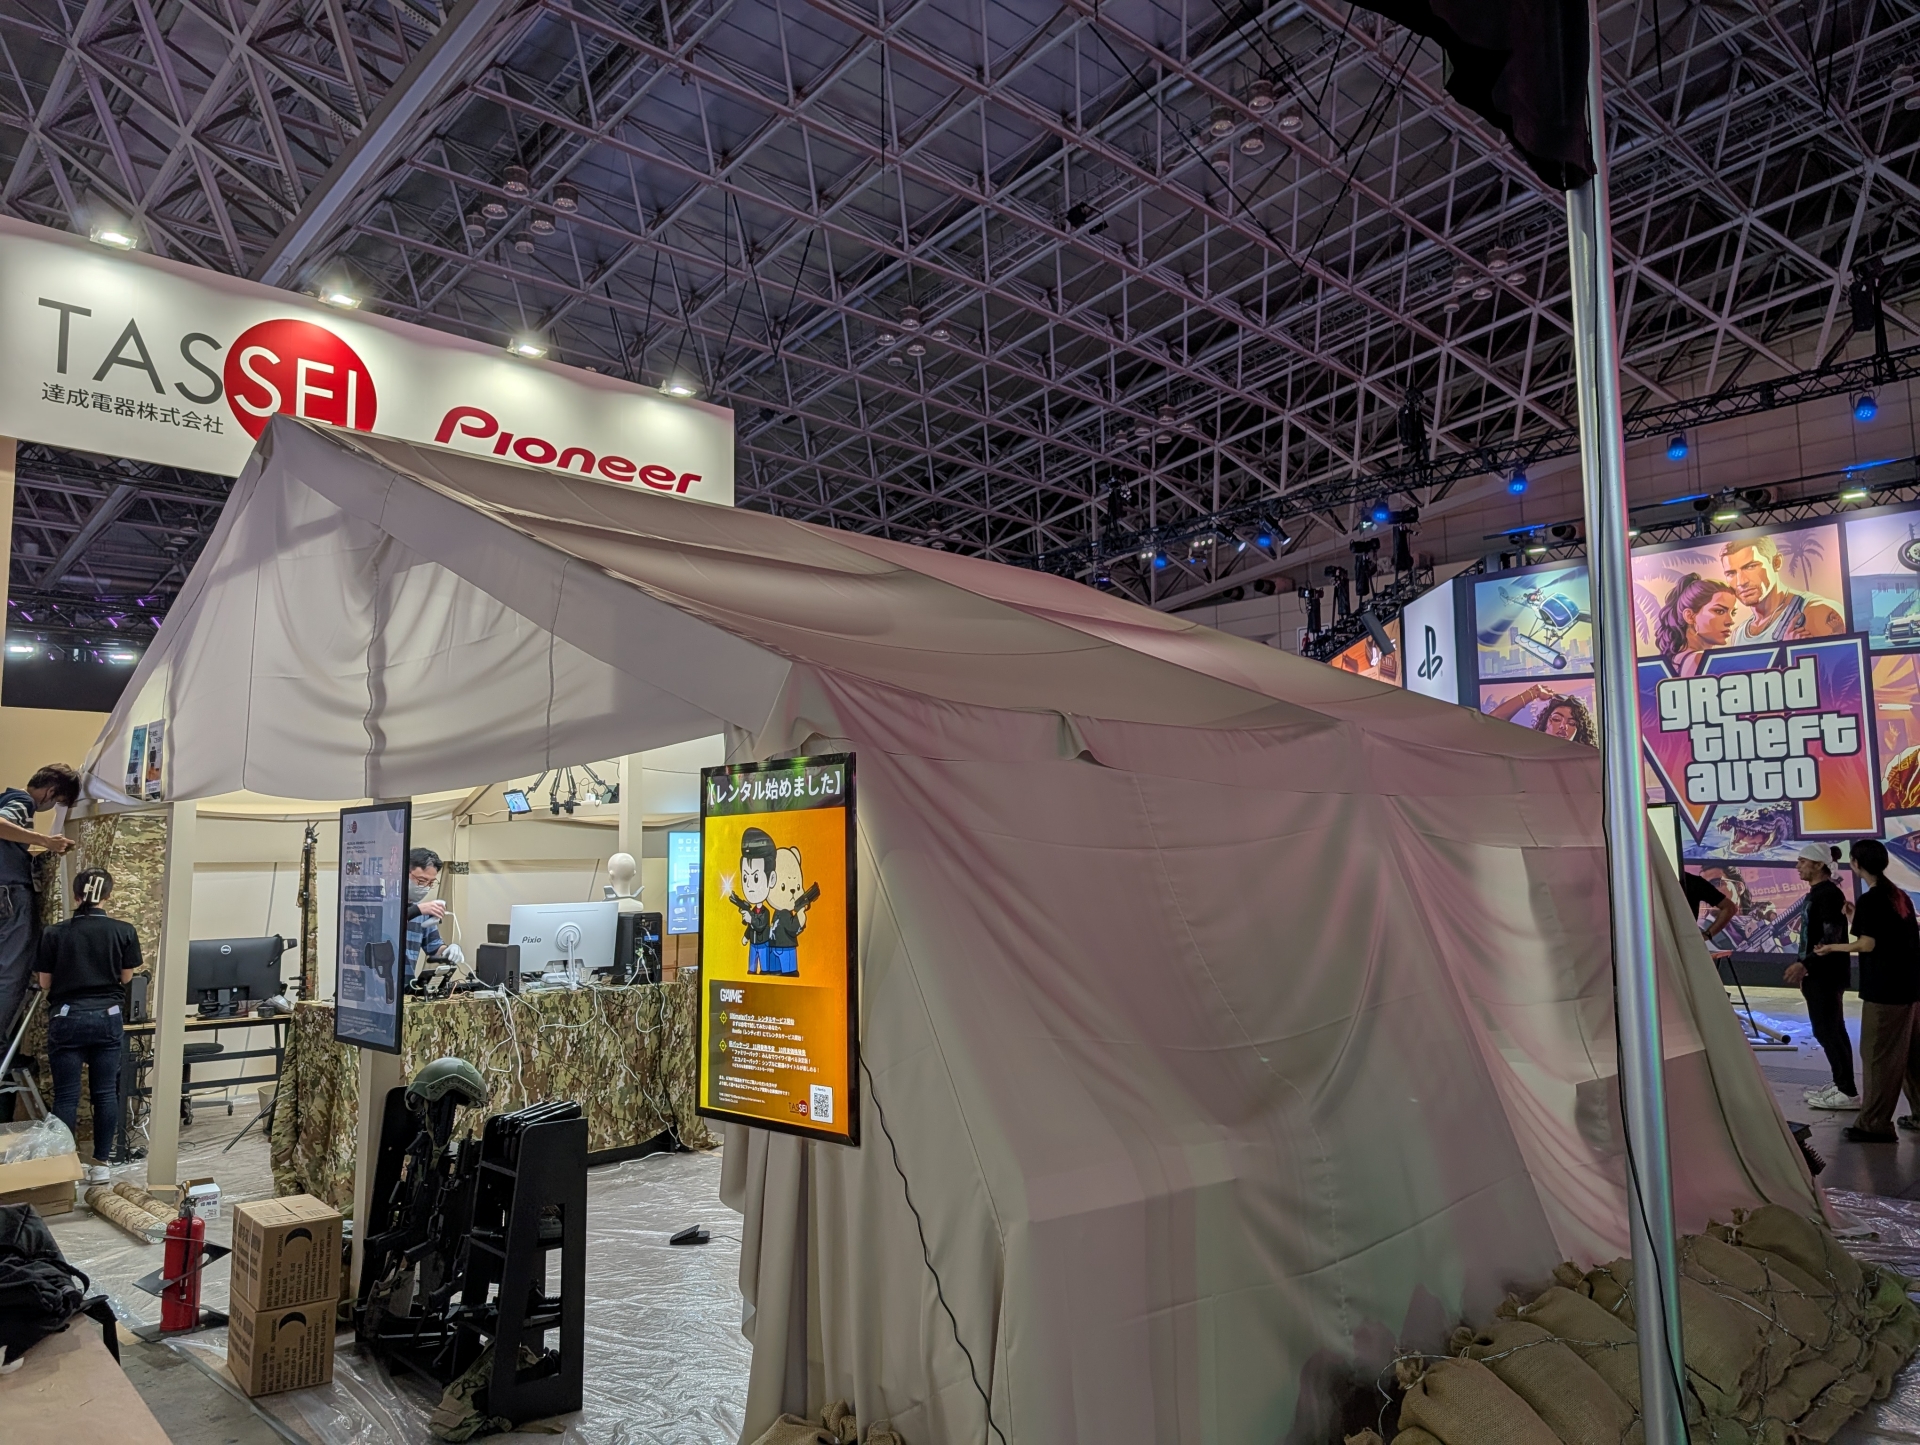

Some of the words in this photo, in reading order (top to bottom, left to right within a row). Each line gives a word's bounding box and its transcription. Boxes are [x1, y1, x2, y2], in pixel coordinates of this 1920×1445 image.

[38, 297, 358, 428] TASSEI
[42, 381, 224, 435] 達成電器株式会社
[434, 406, 702, 494] Pioneer
[1690, 713, 1858, 762] theft
[709, 770, 841, 806] 【レンタル始めました】
[1687, 757, 1818, 802] auto
[1782, 881, 1811, 892] Bank
